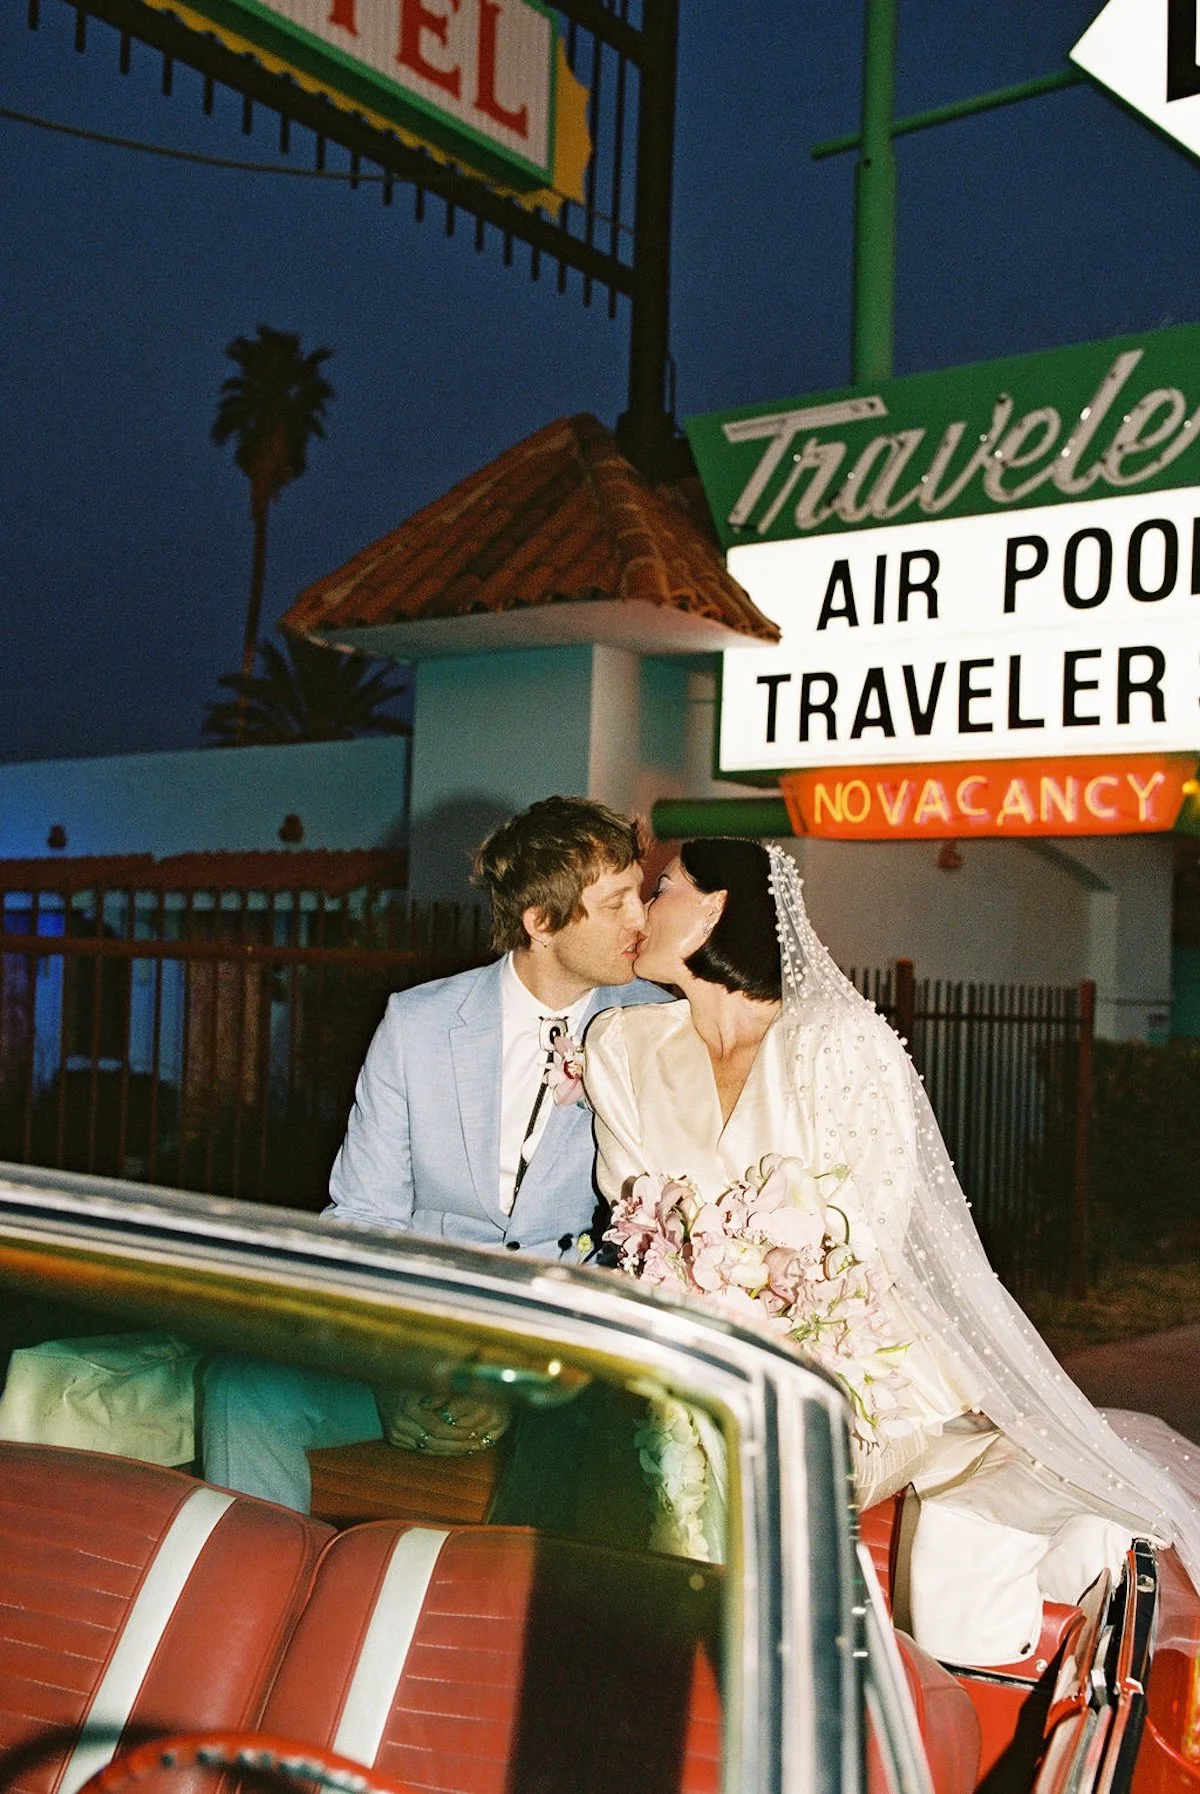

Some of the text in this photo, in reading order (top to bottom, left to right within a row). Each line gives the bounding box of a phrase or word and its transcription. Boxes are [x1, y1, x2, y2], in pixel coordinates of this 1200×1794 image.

[722, 348, 1200, 534] Travele
[816, 517, 1200, 630] AIR POO
[756, 645, 1167, 743] TRAVELER
